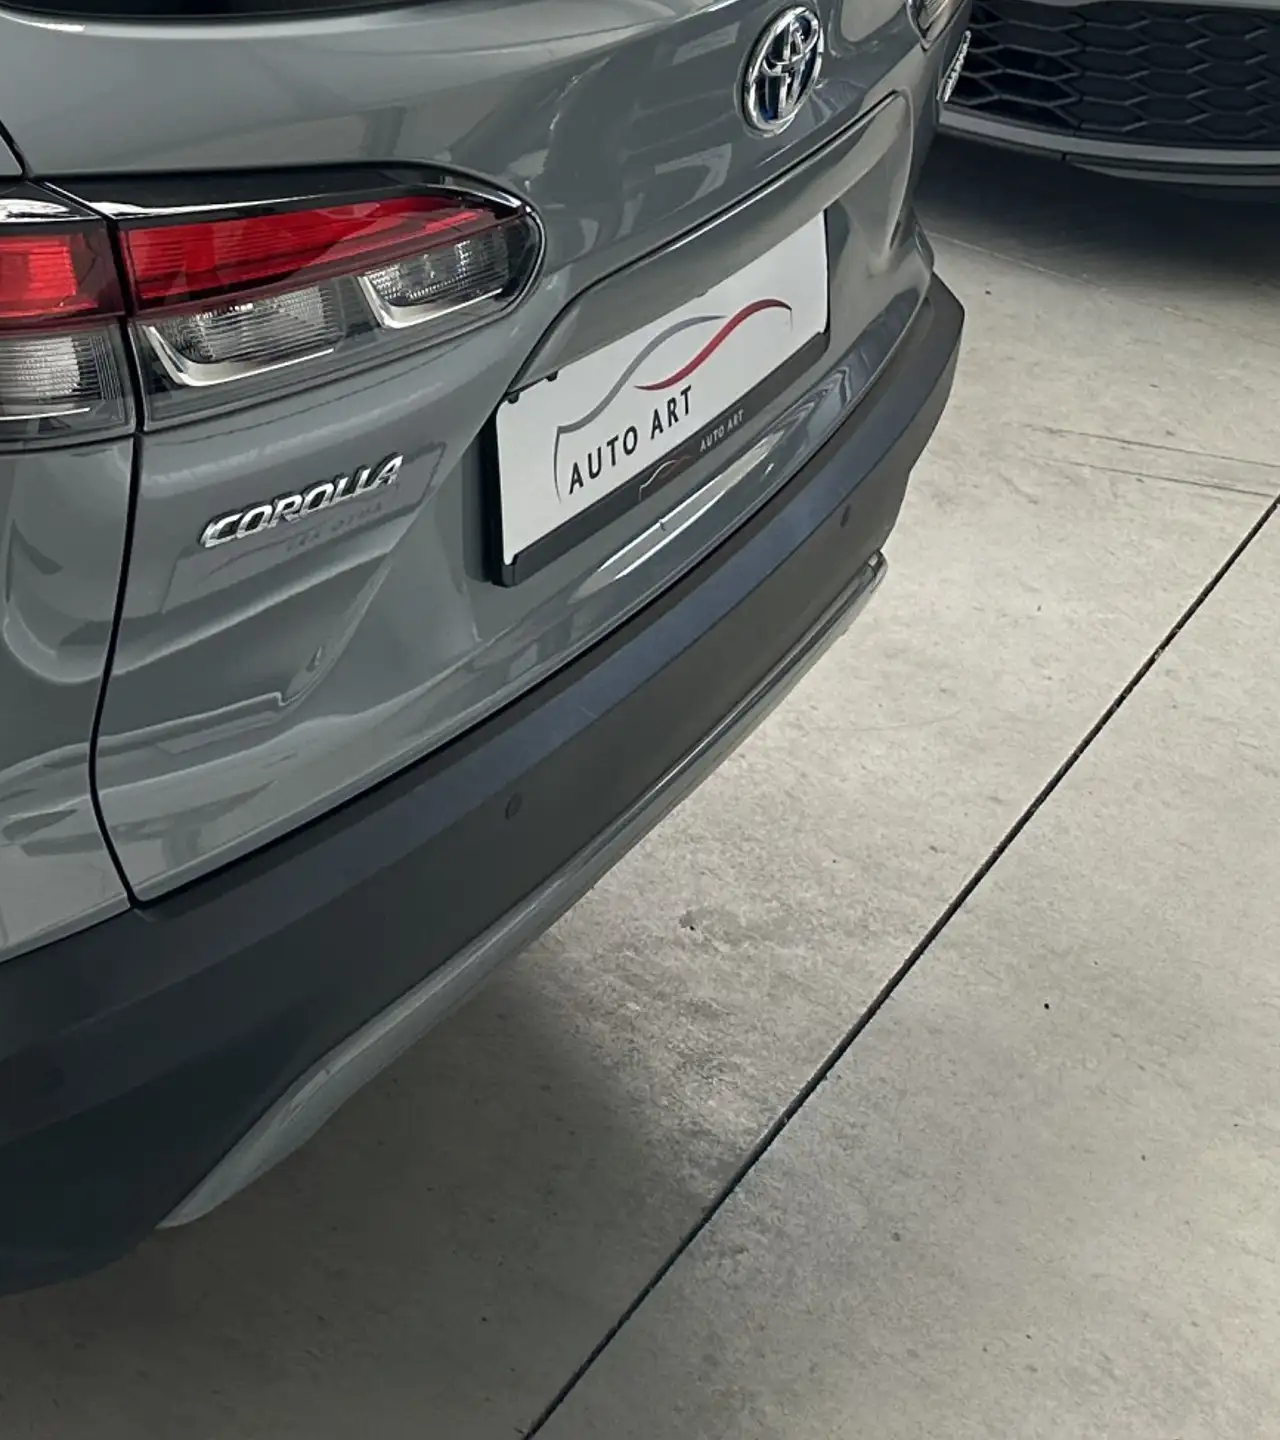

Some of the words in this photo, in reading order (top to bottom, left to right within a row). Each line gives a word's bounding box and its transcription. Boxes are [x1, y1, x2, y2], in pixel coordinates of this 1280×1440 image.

[569, 425, 638, 495] AUTO
[650, 385, 691, 440] ART
[700, 426, 725, 452] AUTO
[727, 409, 744, 434] ART
[199, 453, 403, 548] COROLLA
